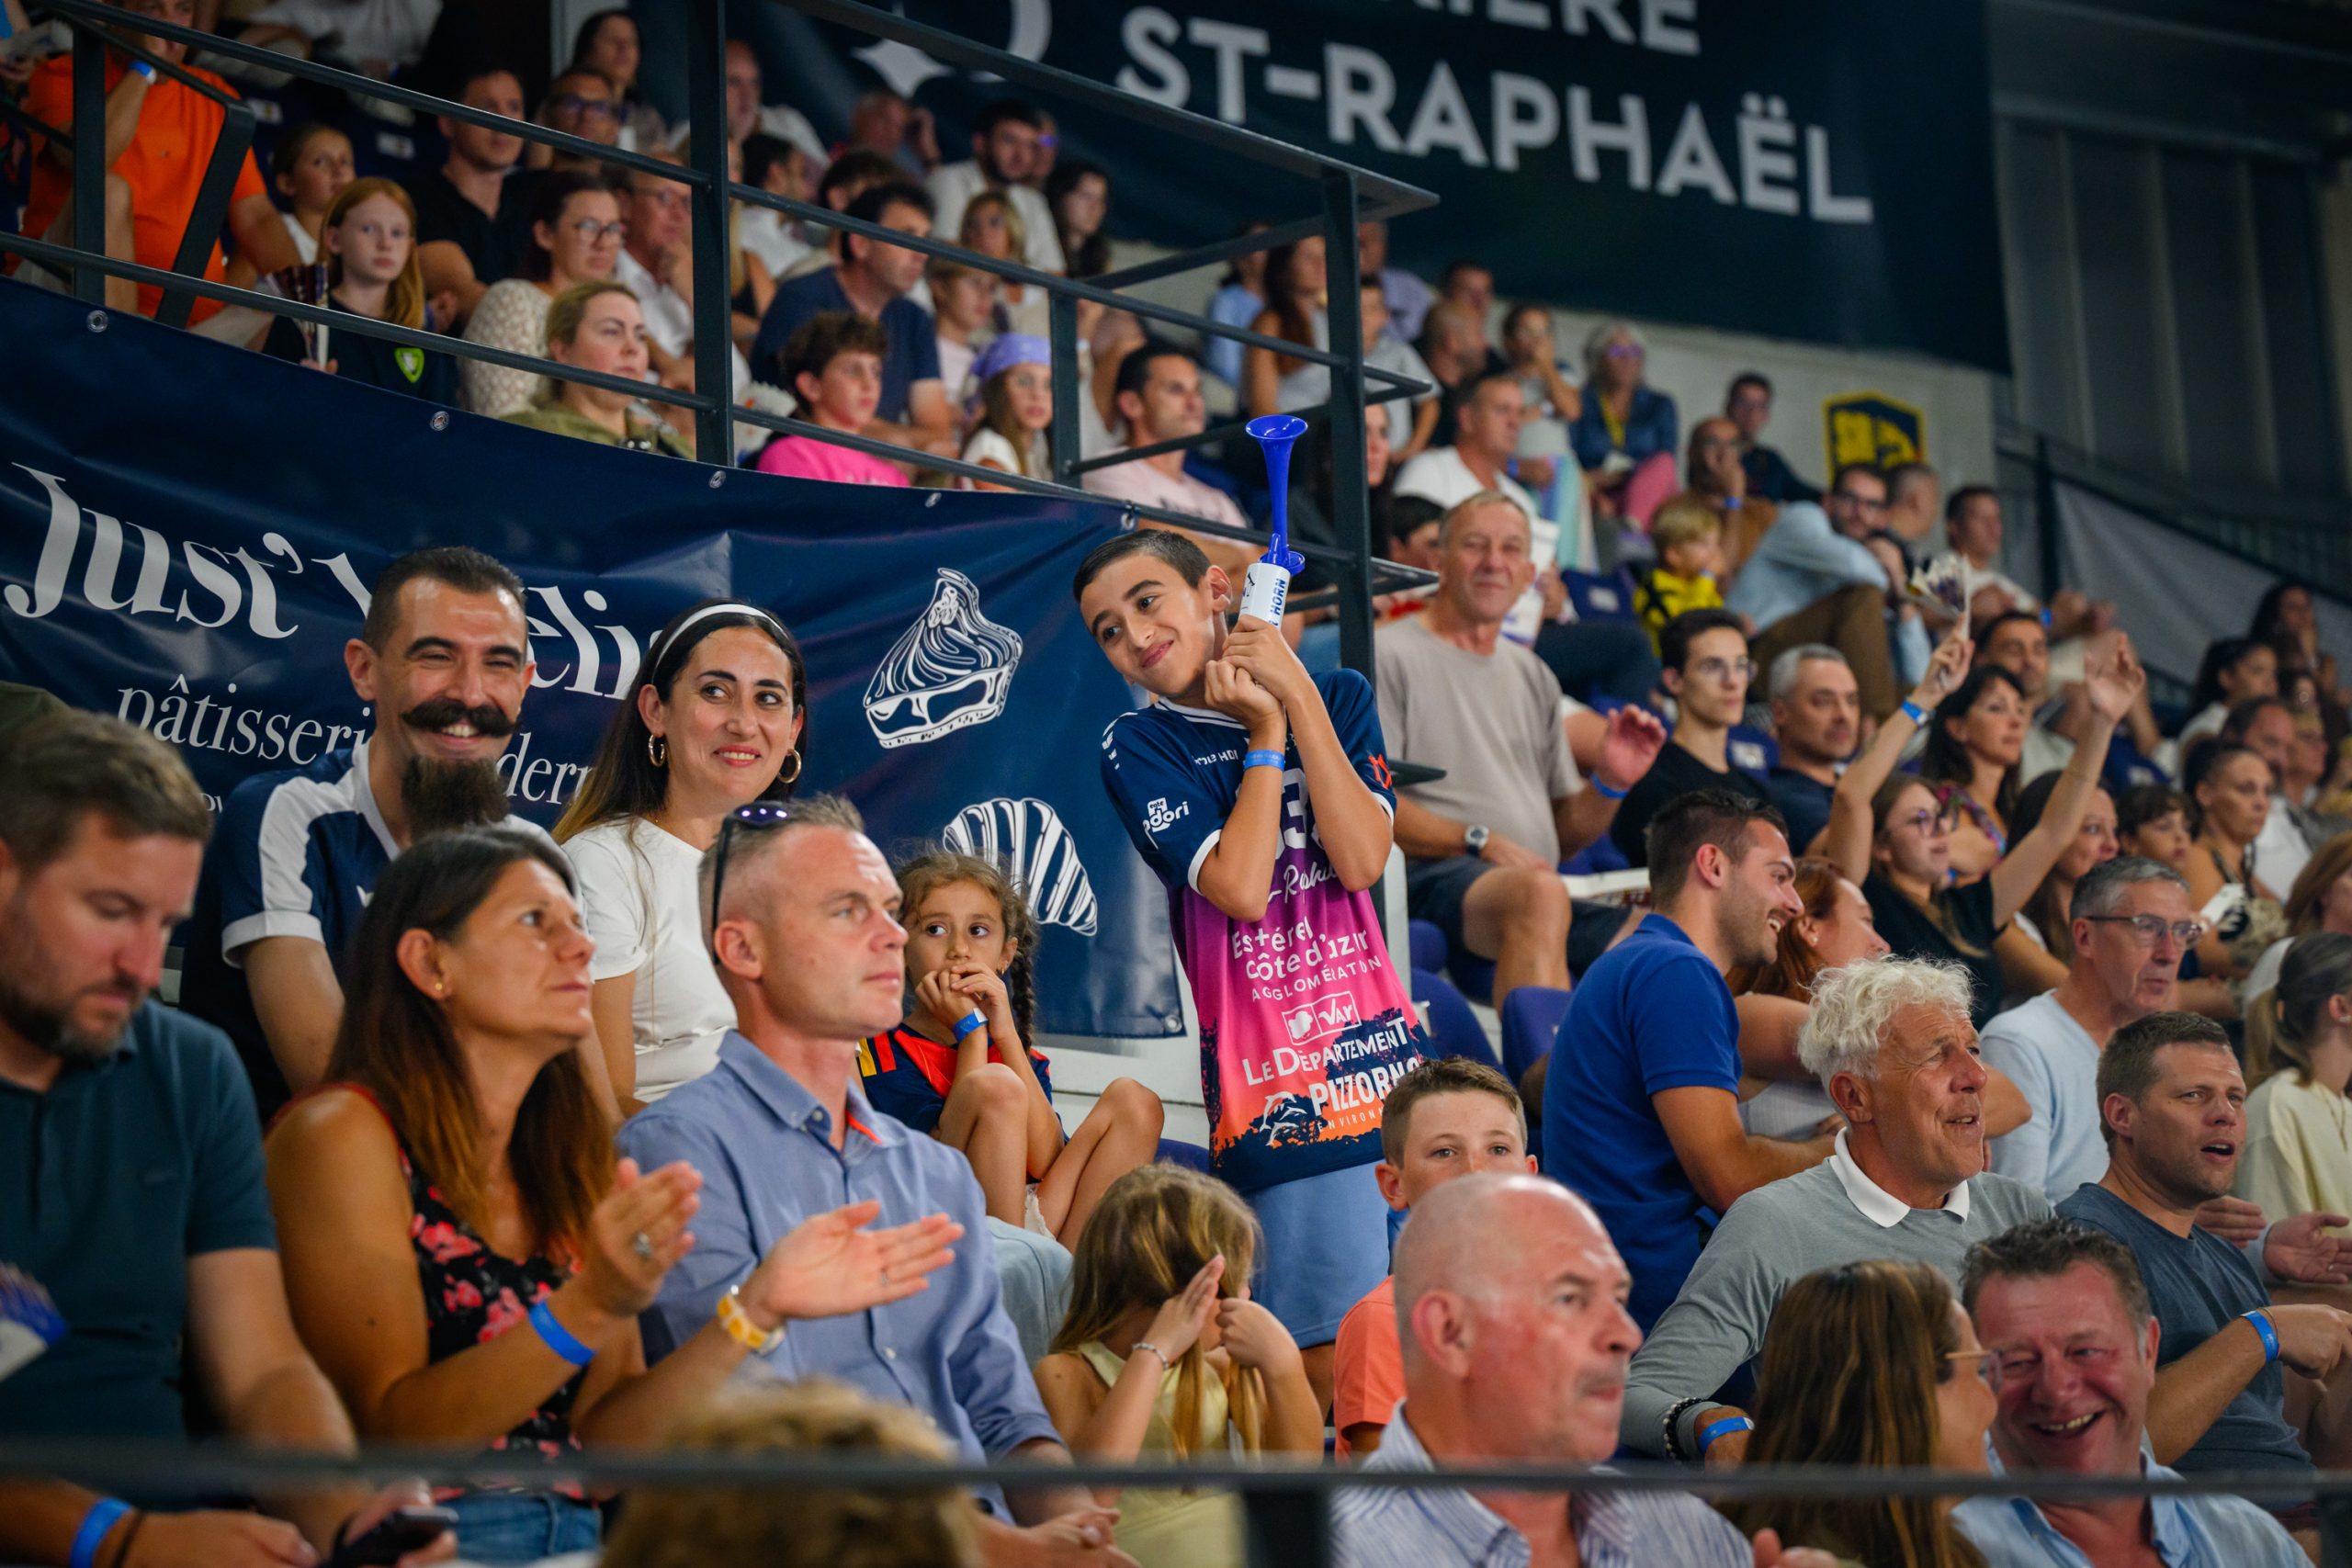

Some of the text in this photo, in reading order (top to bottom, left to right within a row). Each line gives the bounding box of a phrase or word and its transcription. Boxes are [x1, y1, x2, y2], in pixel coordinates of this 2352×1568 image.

[1114, 7, 1874, 224] ST-RAPHAËL
[1270, 578, 1286, 615] HORN
[117, 673, 372, 765] pâtisseri
[1317, 1105, 1384, 1133] ENVIRON
